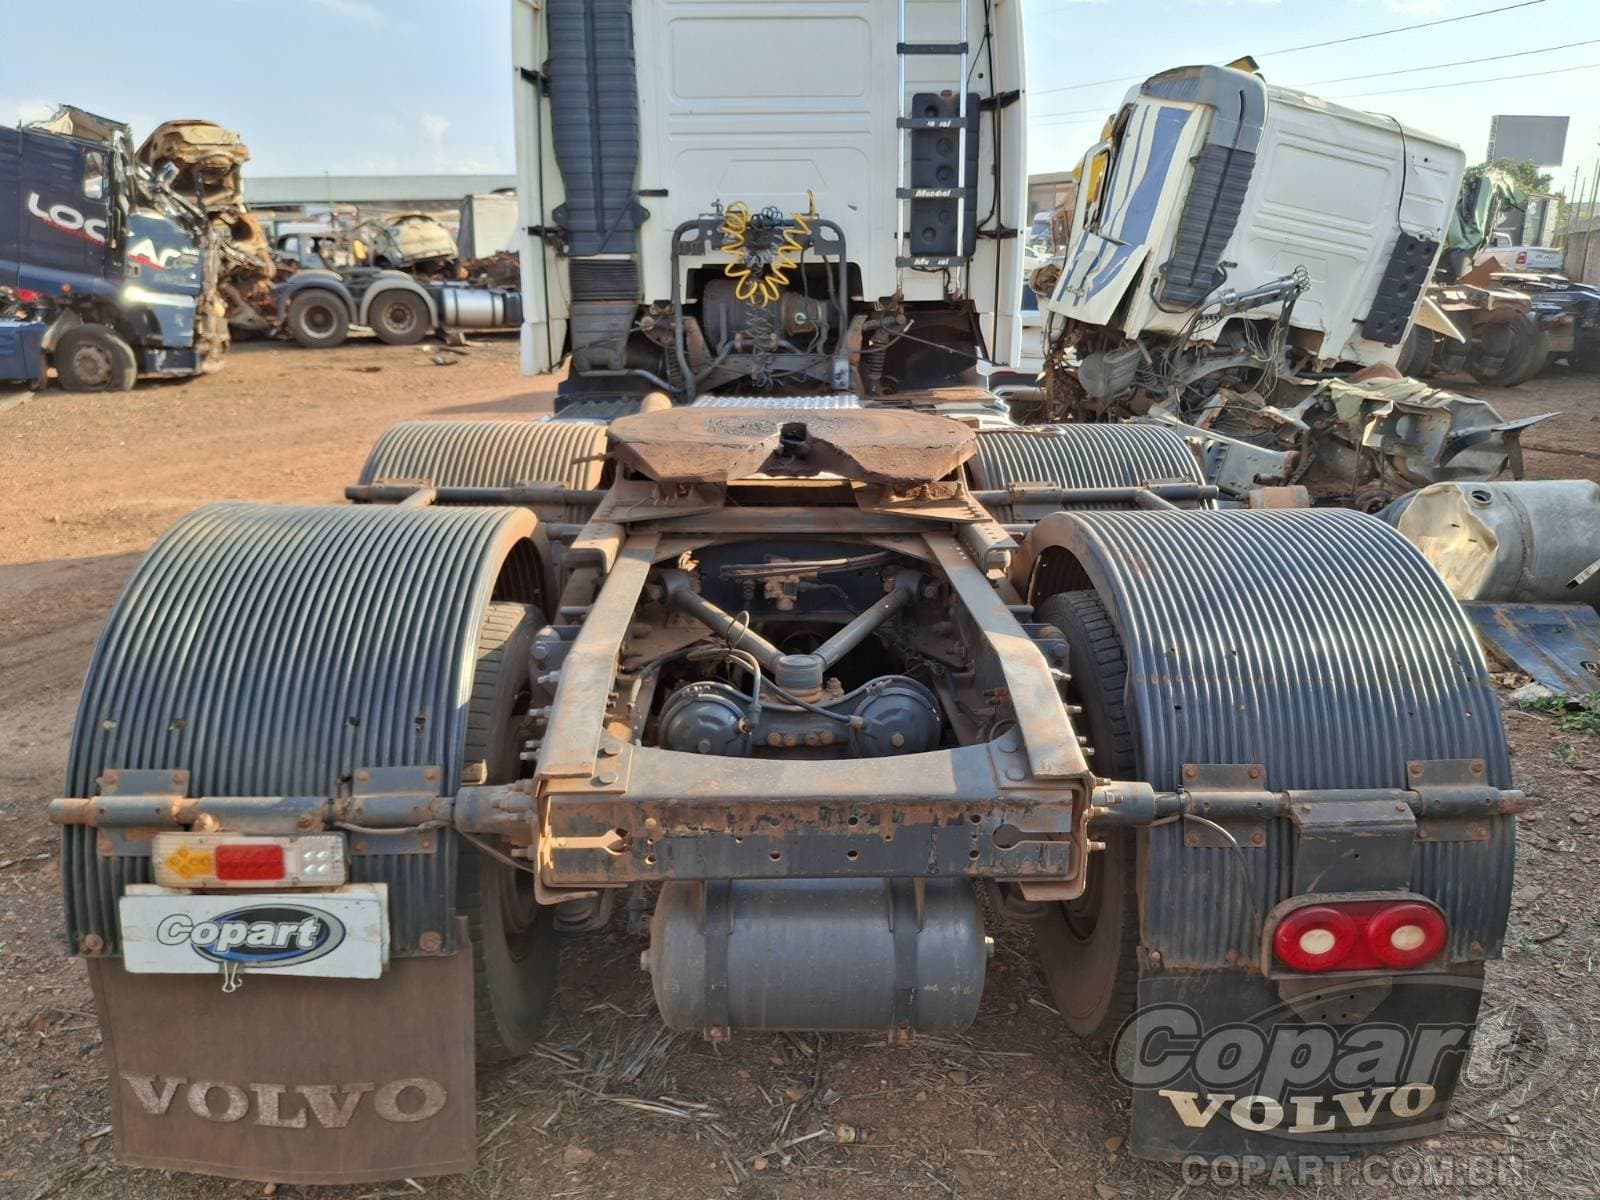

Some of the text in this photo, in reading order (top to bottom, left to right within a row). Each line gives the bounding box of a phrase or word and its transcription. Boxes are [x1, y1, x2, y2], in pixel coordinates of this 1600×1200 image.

[157, 914, 320, 952] Copart
[121, 1073, 448, 1129] VOLVO
[1158, 1083, 1436, 1133] VOLVO
